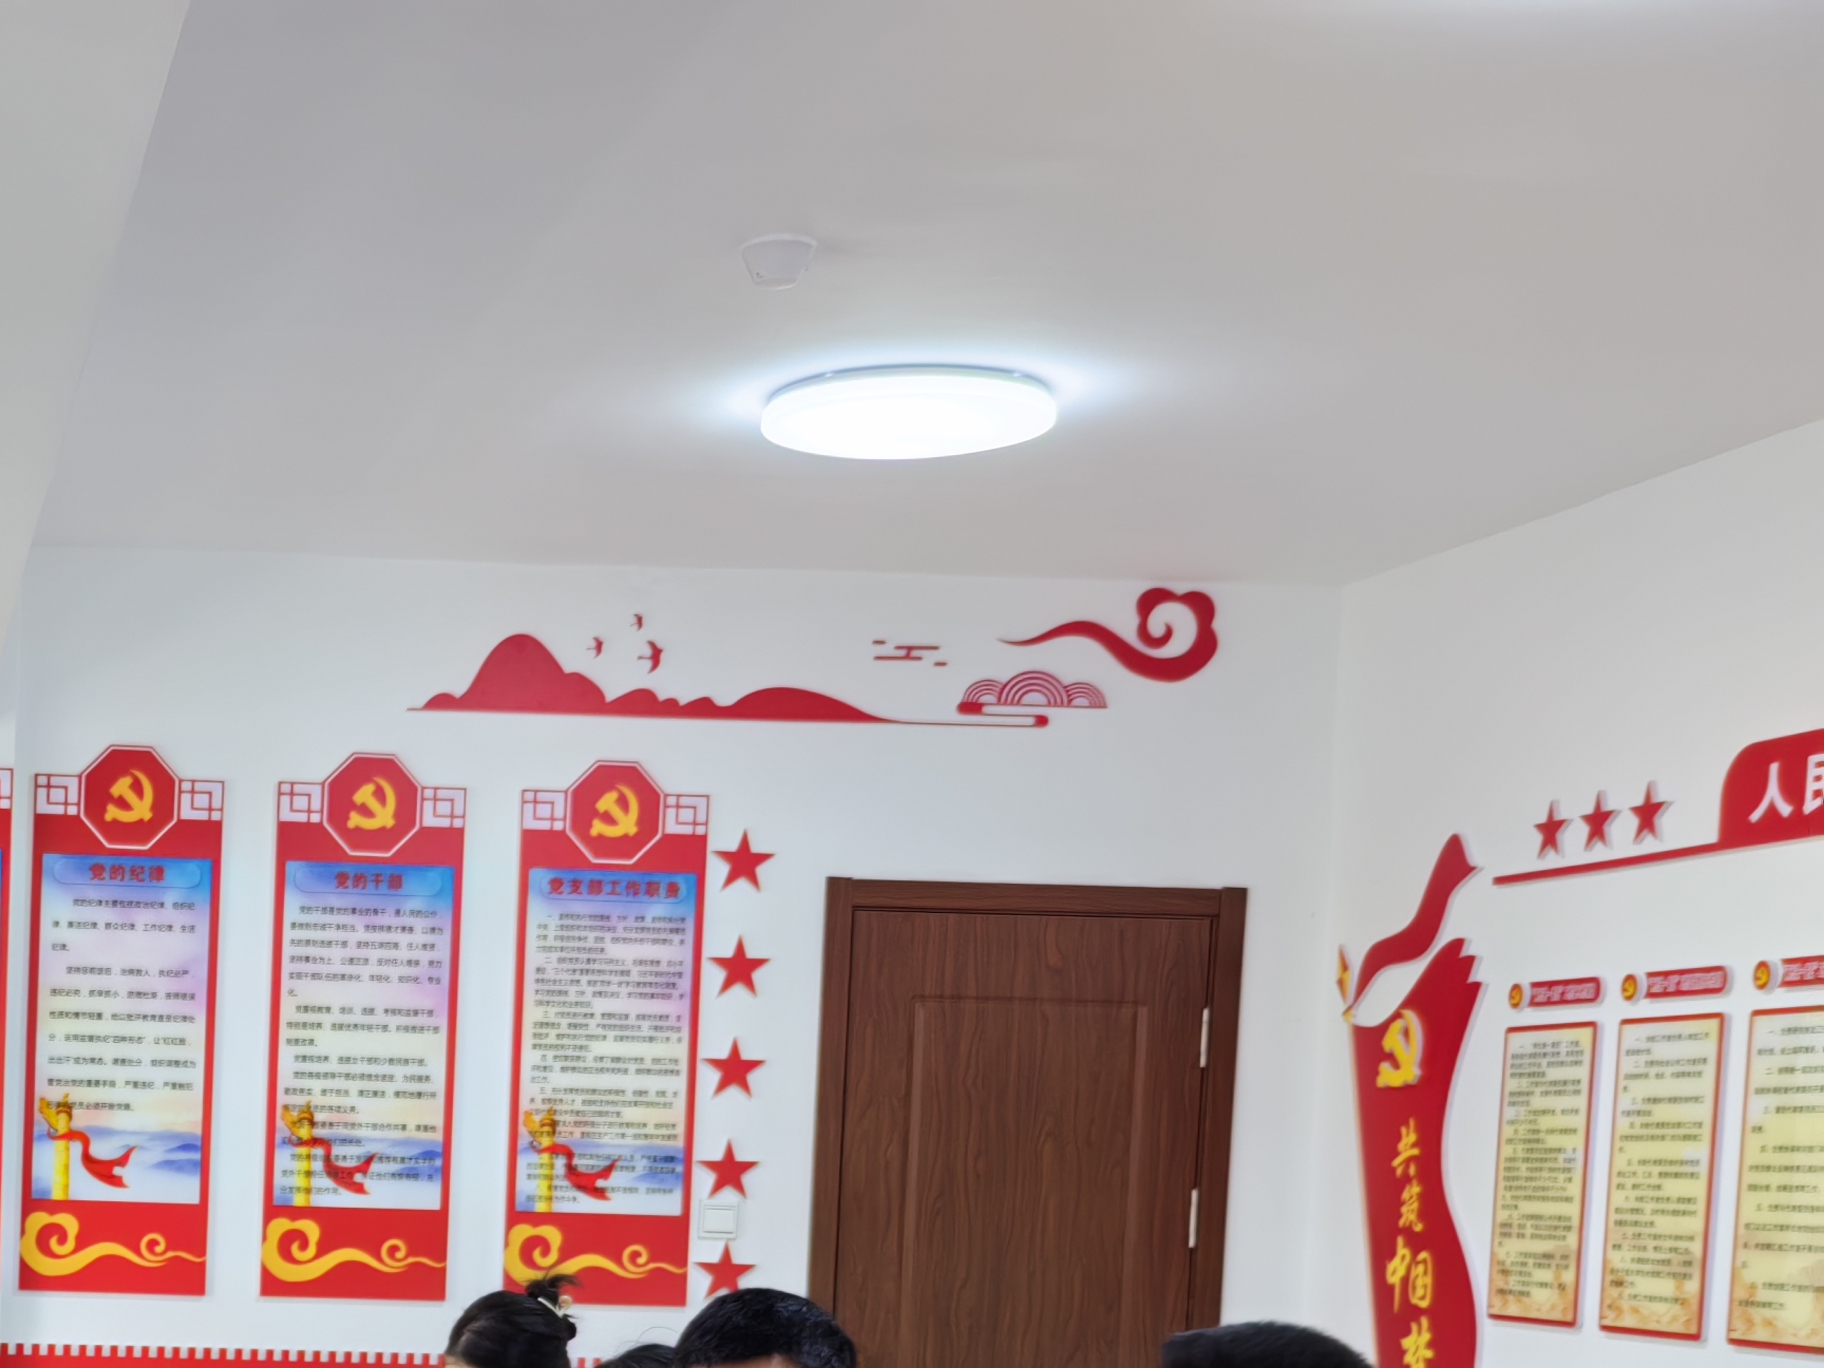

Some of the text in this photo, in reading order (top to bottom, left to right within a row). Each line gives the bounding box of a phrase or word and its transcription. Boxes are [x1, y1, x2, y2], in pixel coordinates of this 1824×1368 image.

[90, 863, 165, 883] 党的纪律
[335, 871, 404, 891] 党的干部
[548, 877, 681, 899] 党支部工作职责
